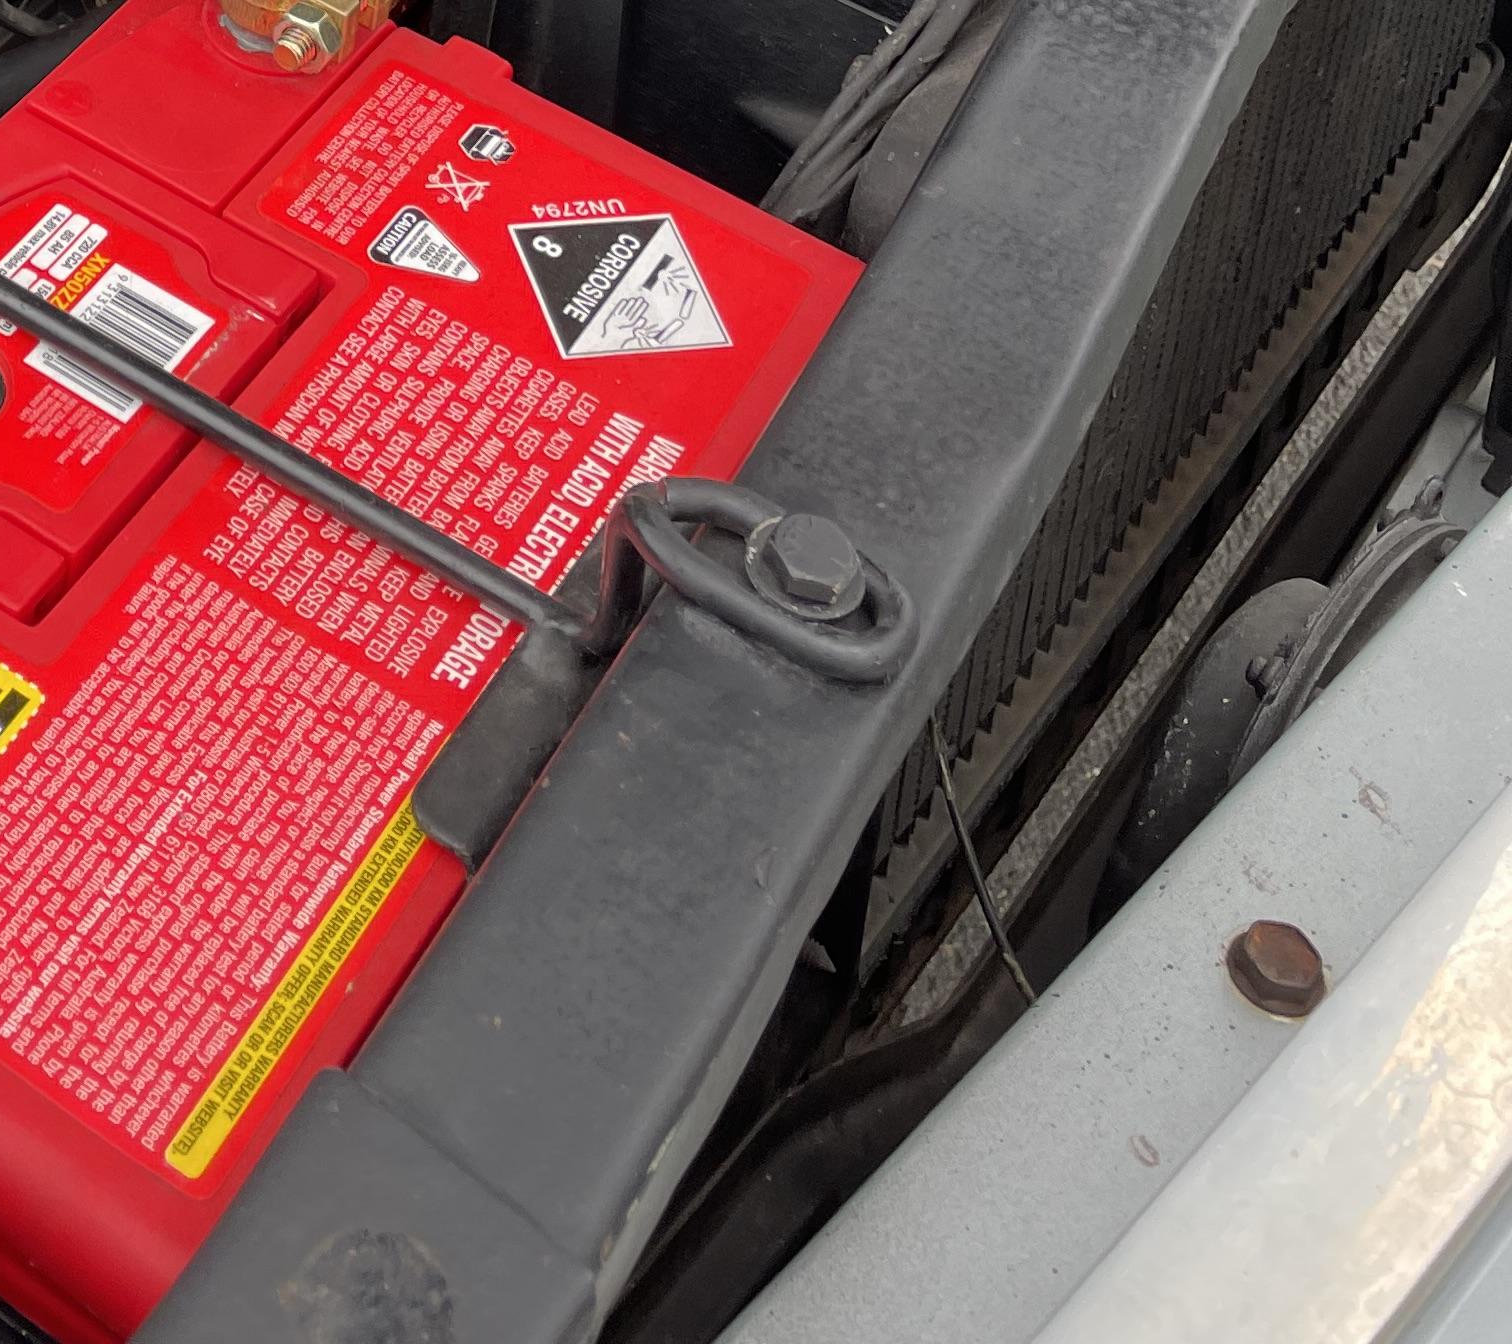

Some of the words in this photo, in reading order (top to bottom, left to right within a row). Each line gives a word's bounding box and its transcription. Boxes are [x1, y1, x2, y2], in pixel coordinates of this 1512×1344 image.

[529, 198, 625, 219] UN2794
[26, 228, 47, 246] max
[46, 239, 65, 255] AH
[75, 235, 97, 253] 720
[374, 210, 418, 255] CAUTION
[417, 240, 439, 261] LOAD
[528, 233, 565, 259] 8
[2, 243, 32, 270] vehicle
[59, 250, 82, 270] CCA
[115, 271, 129, 282] 9
[424, 242, 451, 269] ASSESS
[562, 231, 643, 323] CORROSIVE
[77, 282, 119, 323] 313122
[353, 283, 406, 338] CONTACT
[390, 295, 427, 329] WITH
[335, 330, 368, 359] SEE
[362, 323, 405, 365] LARGE
[408, 306, 448, 343] EYES,
[328, 351, 351, 368] A
[387, 340, 422, 373] SKIN
[414, 319, 470, 378] CONTAINS
[445, 329, 492, 374] SPACE,
[283, 361, 343, 424] PHYSICIAN
[324, 357, 377, 412] AMOUNT
[370, 369, 399, 394] OR
[456, 342, 513, 404] CHARGING
[482, 354, 534, 410] OBJECTS
[309, 405, 338, 431] OF
[319, 389, 382, 455] CLOTHING,
[363, 374, 426, 442] SULPHURIC
[405, 375, 457, 429] PROVIDE
[441, 399, 470, 424] OR
[459, 402, 498, 441] AWAY
[493, 366, 556, 438] CIGARETTES
[534, 379, 579, 425] GASES.
[564, 390, 602, 428] LEAD
[337, 437, 377, 475] ACID.
[413, 418, 455, 461] USING
[434, 433, 476, 475] FROM
[467, 432, 507, 473] AWAY
[508, 424, 546, 462] KEEP
[539, 426, 576, 462] ACID
[587, 410, 645, 466] WITH
[237, 481, 277, 521] CASE
[401, 467, 451, 520] BATTER
[440, 468, 481, 511] FROM
[471, 460, 520, 514] SPARKS
[490, 462, 550, 531] BATTERIES
[549, 451, 613, 513] ACID,
[201, 532, 235, 565] EYE
[221, 514, 250, 540] OF
[223, 493, 300, 580] IMMEDIATELY
[317, 515, 349, 545] HIS
[343, 527, 371, 553] AN
[504, 501, 580, 586] ELECTRI
[246, 521, 310, 593] CONTACTS
[268, 545, 325, 607] BATTERY
[291, 548, 356, 621] ENCLOSED
[371, 564, 411, 604] KEEP
[406, 568, 441, 603] AND
[314, 588, 359, 635] WHEN
[337, 599, 385, 650] METAL
[360, 602, 416, 664] LIGHTED
[384, 604, 450, 679] EXPLOSIVE
[427, 602, 513, 694] TORAGE.
[400, 717, 445, 772] Marshall
[374, 766, 411, 809] Power
[336, 804, 385, 864] Standard
[377, 832, 400, 856] KM
[289, 858, 348, 933] Nationwide
[342, 850, 388, 908] EXTENDED
[363, 884, 385, 908] KM
[302, 902, 353, 966] WARRANTY
[326, 902, 373, 963] STANDARD
[243, 925, 300, 995] Warranty:
[225, 990, 256, 1025] This
[255, 998, 287, 1036] SCAN
[262, 958, 336, 1058] MANUFACTURERS
[191, 1015, 237, 1071] Battery
[230, 1049, 252, 1072] OR
[184, 1064, 205, 1085] is
[210, 1065, 241, 1101] VISIT
[220, 1051, 272, 1121] WARRANTY
[138, 1079, 195, 1152] warranted
